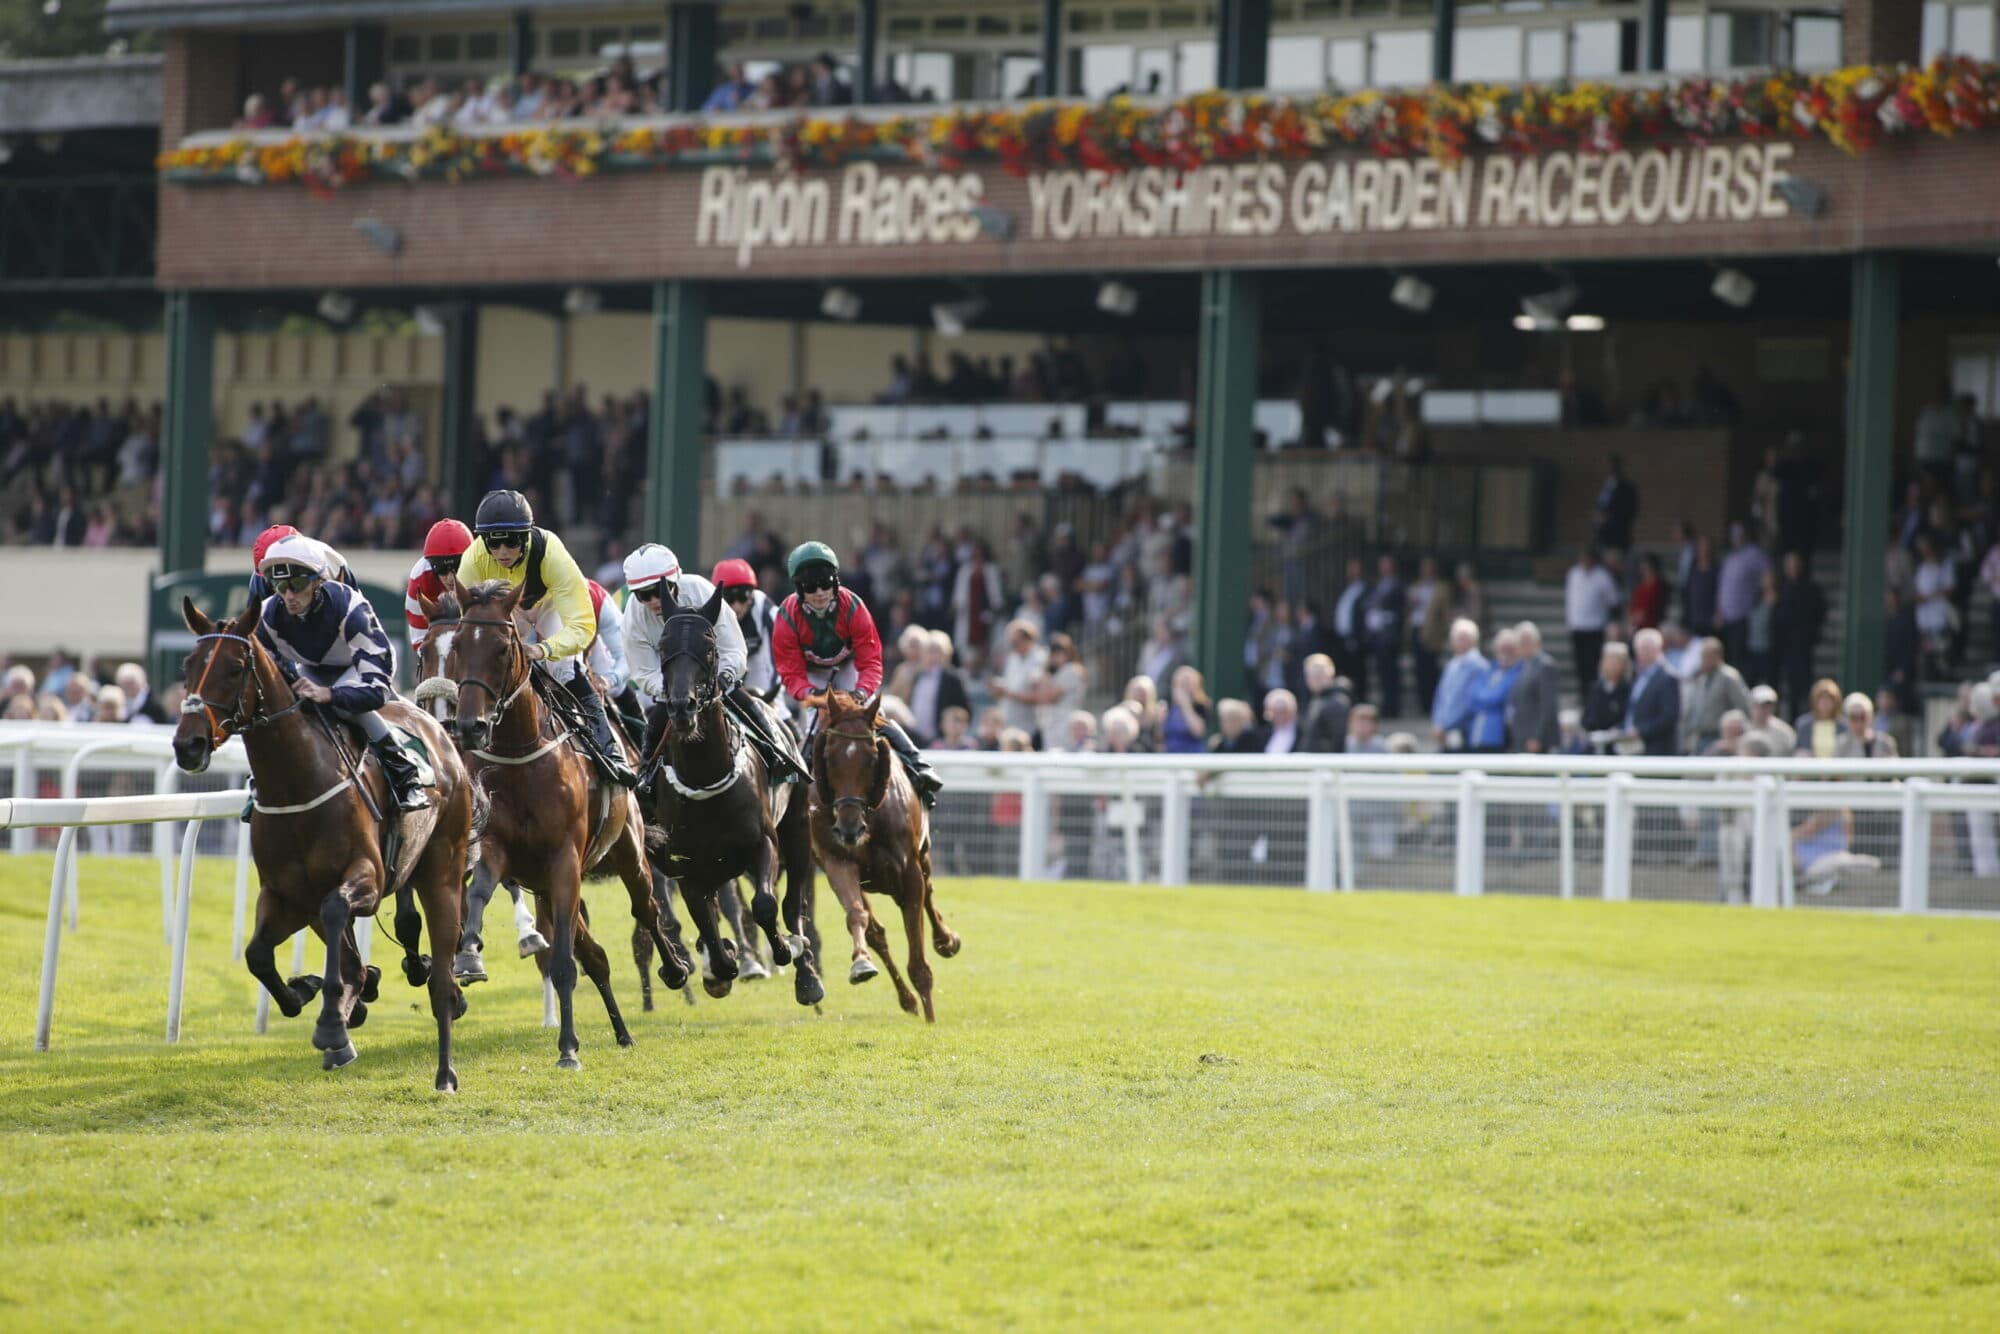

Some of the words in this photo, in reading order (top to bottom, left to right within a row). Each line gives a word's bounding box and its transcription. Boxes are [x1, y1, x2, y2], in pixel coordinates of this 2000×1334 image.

[697, 165, 829, 268] Ripon
[838, 162, 984, 246] Races
[1291, 158, 1474, 234] GARDEN
[1478, 143, 1793, 226] RACECOURSE
